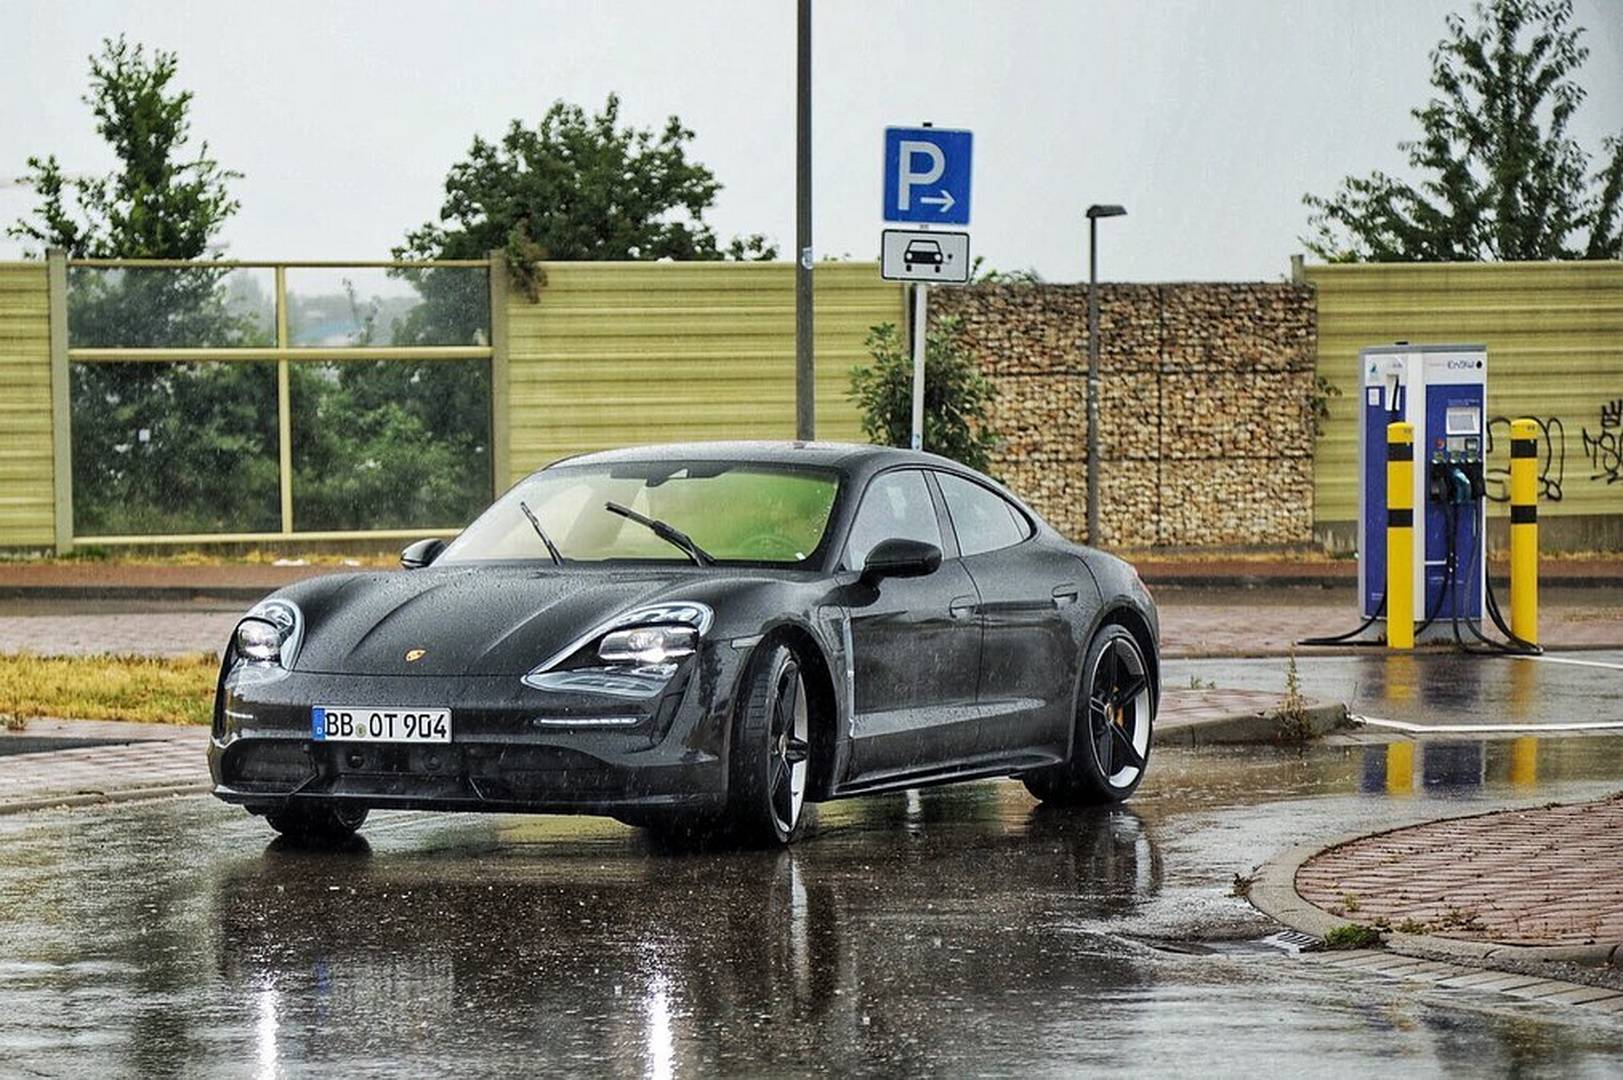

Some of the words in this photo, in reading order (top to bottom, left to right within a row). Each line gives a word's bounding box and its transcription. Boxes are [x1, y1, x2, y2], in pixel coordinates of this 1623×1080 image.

[898, 140, 945, 211] P
[326, 712, 353, 737] BB
[369, 713, 398, 738] OT
[403, 714, 447, 738] 904
